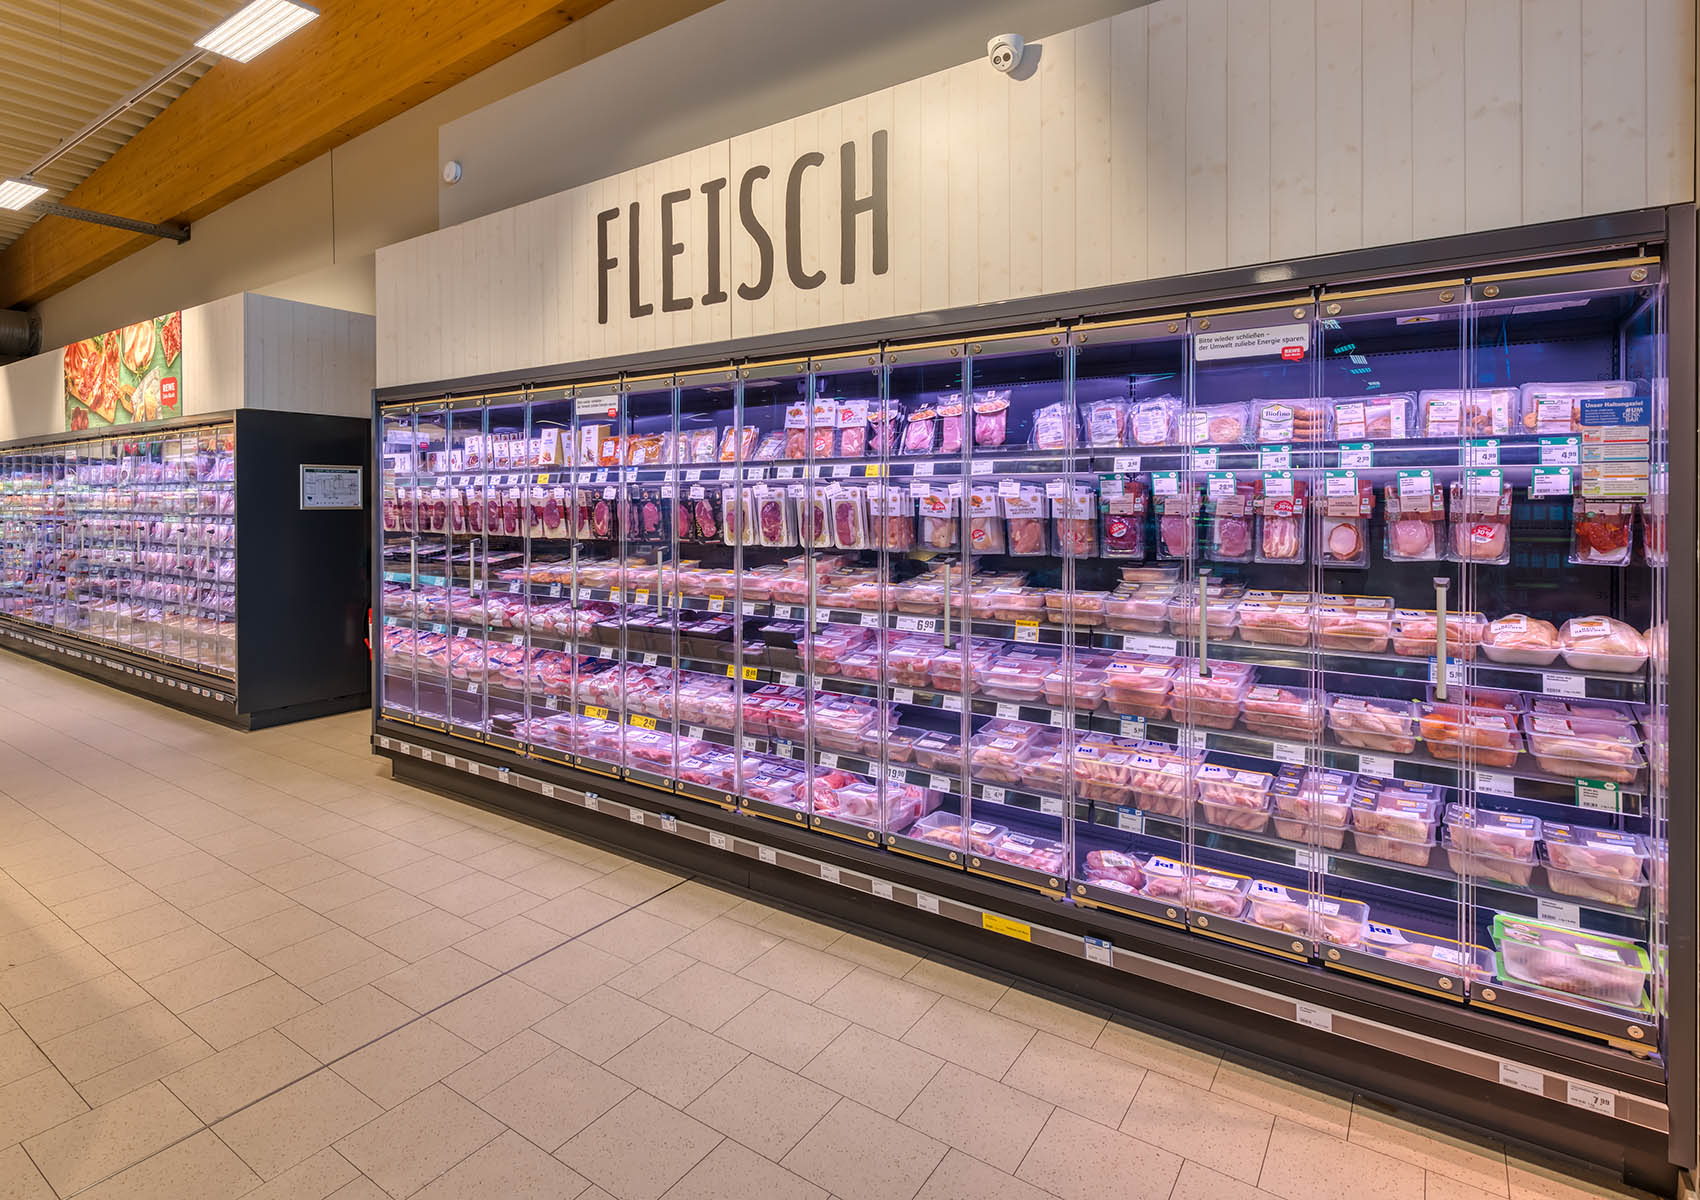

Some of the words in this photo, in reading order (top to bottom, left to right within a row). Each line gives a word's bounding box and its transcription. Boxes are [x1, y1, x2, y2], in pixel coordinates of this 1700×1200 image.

[597, 129, 889, 324] FLEISCH
[1210, 342, 1233, 350] Umwelt
[1257, 337, 1280, 347] Energie
[1281, 336, 1305, 345] sparen.
[1214, 334, 1235, 343] wieder
[1236, 332, 1265, 341] schließen
[162, 383, 175, 392] REWE
[1604, 400, 1644, 408] Haltungsziel
[1265, 410, 1291, 418] Biofino
[916, 619, 934, 631] 6,99
